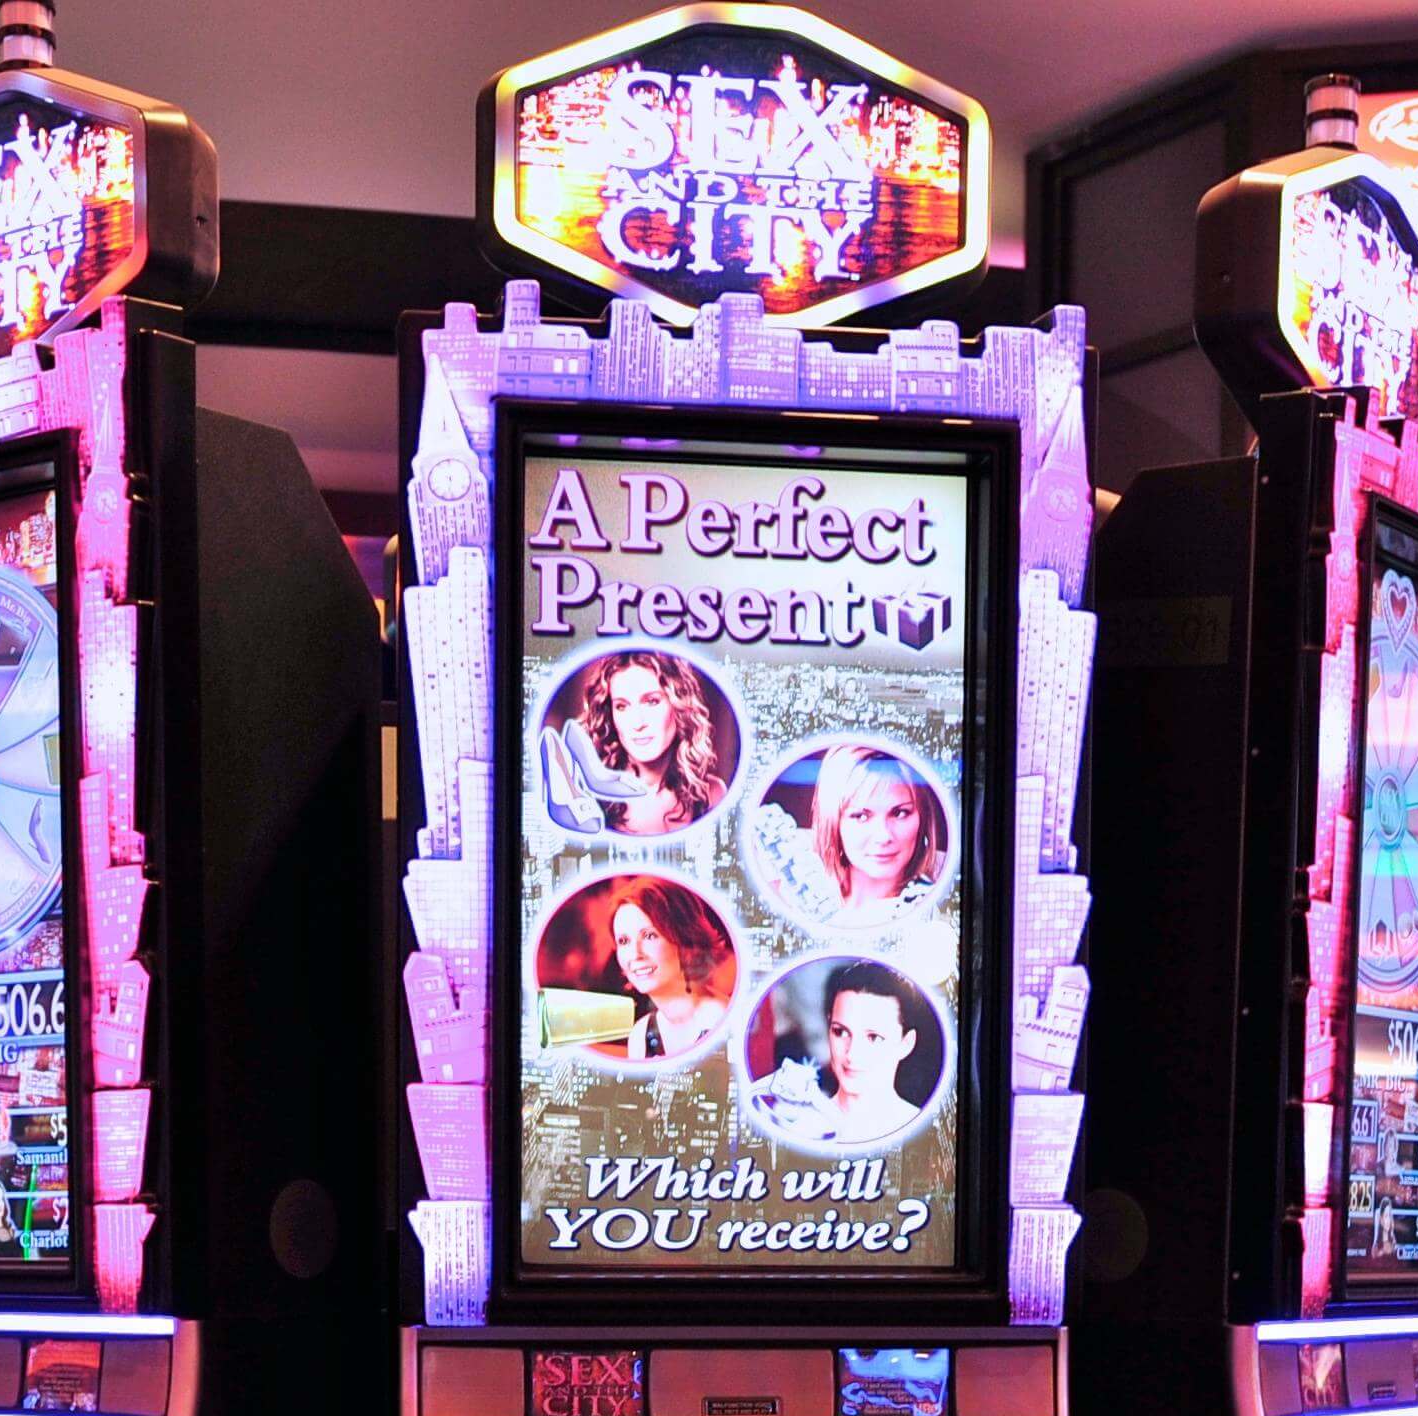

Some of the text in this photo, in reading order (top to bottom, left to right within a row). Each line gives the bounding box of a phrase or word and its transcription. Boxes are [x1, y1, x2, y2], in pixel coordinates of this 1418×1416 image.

[604, 70, 869, 181] SEX
[604, 167, 876, 212] AND THE
[5, 213, 85, 256] THE
[599, 199, 871, 281] CITY
[528, 467, 939, 566] A Perfect
[531, 555, 867, 649] Present
[584, 1155, 885, 1202] Which will
[544, 1198, 930, 1253] YOU receive?
[543, 1355, 628, 1386] SEX
[543, 1385, 589, 1396] AND
